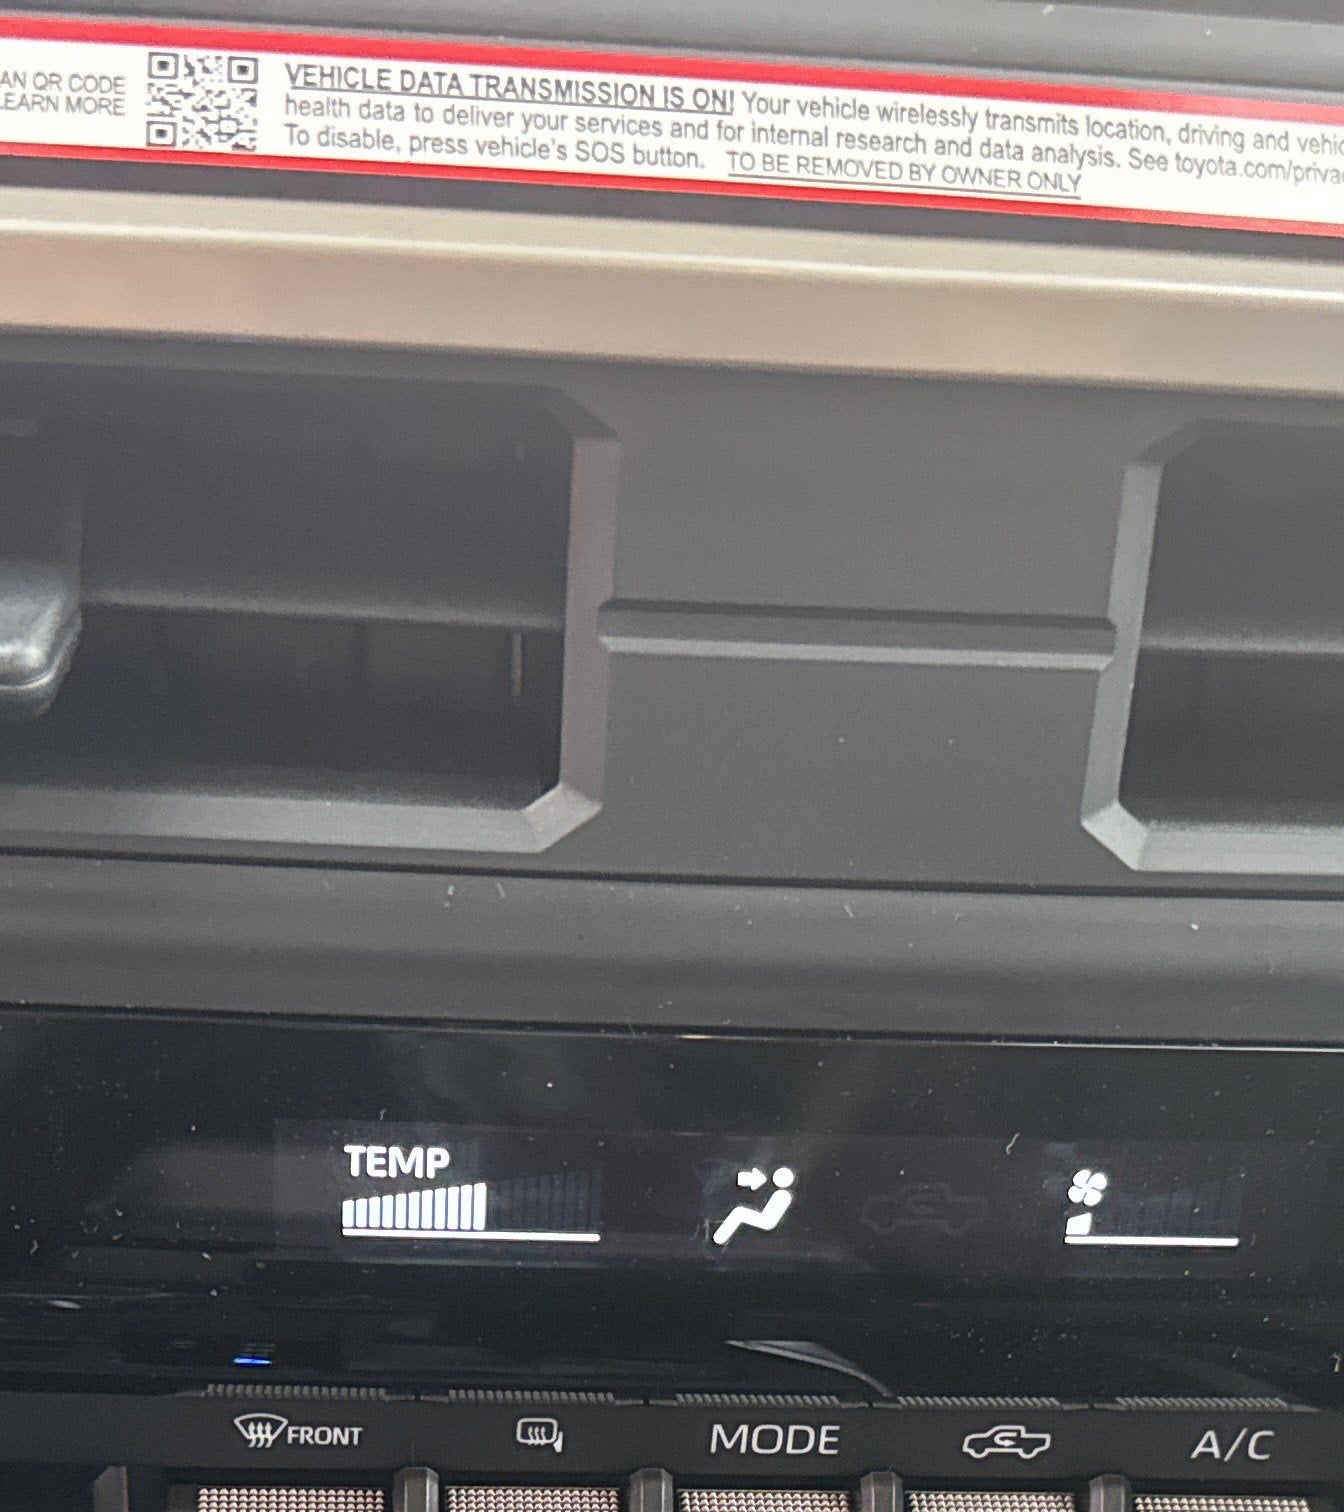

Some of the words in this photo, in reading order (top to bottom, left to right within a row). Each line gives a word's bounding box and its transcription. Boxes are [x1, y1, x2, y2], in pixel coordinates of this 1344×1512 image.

[33, 72, 63, 91] QR
[68, 73, 126, 94] CODE
[66, 95, 126, 116] MORE
[285, 63, 392, 91] VEHICLE
[400, 69, 462, 95] DATA
[470, 73, 654, 107] TRANSMISSION
[663, 85, 684, 110] IS
[693, 87, 734, 113] ON!
[741, 90, 791, 115] Your
[796, 95, 870, 121] vehicle
[876, 101, 978, 134] wirelessly
[985, 108, 1079, 136] transmits
[1086, 114, 1171, 146] location,
[1178, 122, 1245, 153] driving
[1253, 130, 1289, 152] and
[285, 93, 351, 119] health
[358, 98, 405, 121] data
[414, 103, 433, 123] to
[443, 104, 514, 128] deliver
[521, 111, 568, 134] your
[575, 114, 663, 137] services
[670, 119, 708, 141] and
[716, 119, 743, 142] for
[751, 124, 828, 148] internal
[836, 130, 926, 155] research
[934, 136, 972, 158] and
[980, 137, 1024, 162] data
[1031, 142, 1121, 170] analysis.
[1128, 147, 1169, 173] See
[284, 123, 310, 146] To
[317, 124, 401, 154] disable,
[409, 133, 467, 156] press
[475, 136, 567, 162] vehicle's
[575, 140, 625, 164] SOS
[633, 143, 705, 169] button.
[727, 150, 755, 171] TO
[762, 153, 790, 173] BE
[796, 155, 903, 181] REMOVED
[909, 162, 936, 182] BY
[942, 164, 1021, 188] OWNER
[1027, 170, 1082, 193] ONLY
[343, 1145, 450, 1179] TEMP
[287, 1425, 362, 1447] FRONT
[710, 1423, 841, 1456] MODE
[1190, 1429, 1276, 1463] A/C
